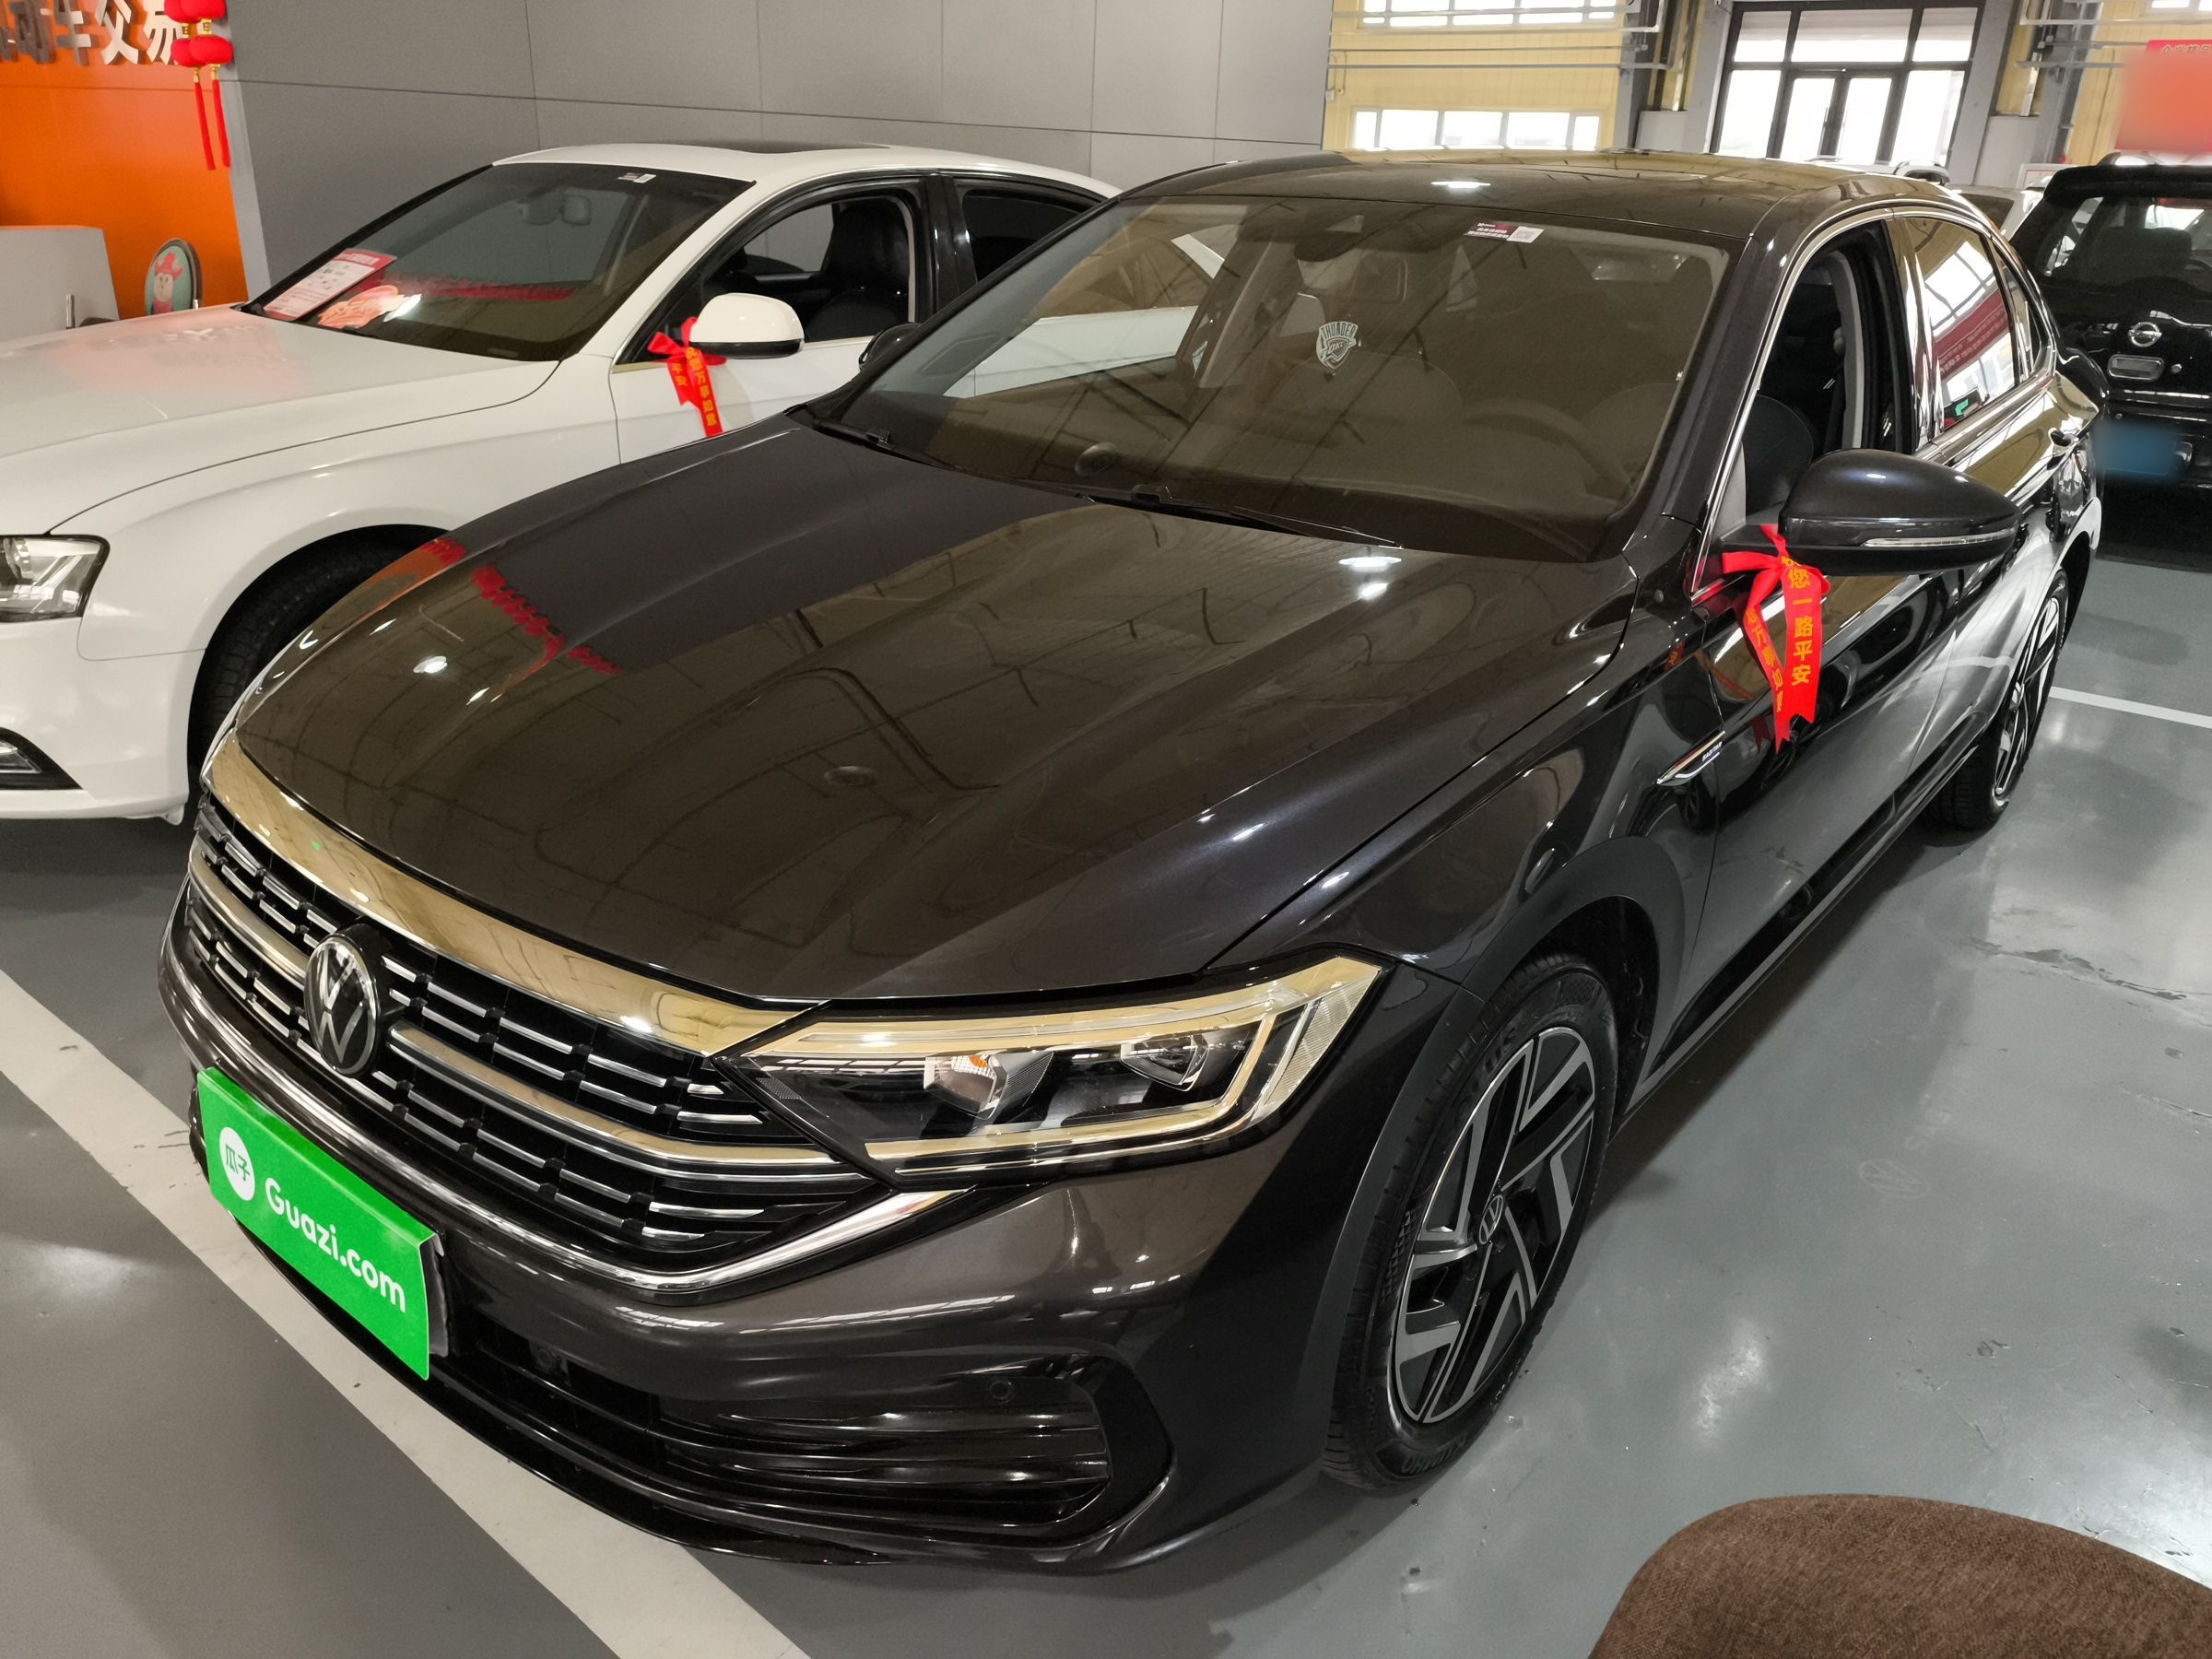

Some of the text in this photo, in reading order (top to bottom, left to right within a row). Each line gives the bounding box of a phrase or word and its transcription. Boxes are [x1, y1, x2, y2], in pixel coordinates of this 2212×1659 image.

[1321, 323, 1357, 339] THUNDER
[224, 1143, 251, 1182] 瓜子
[265, 1177, 406, 1312] Guazi.com
